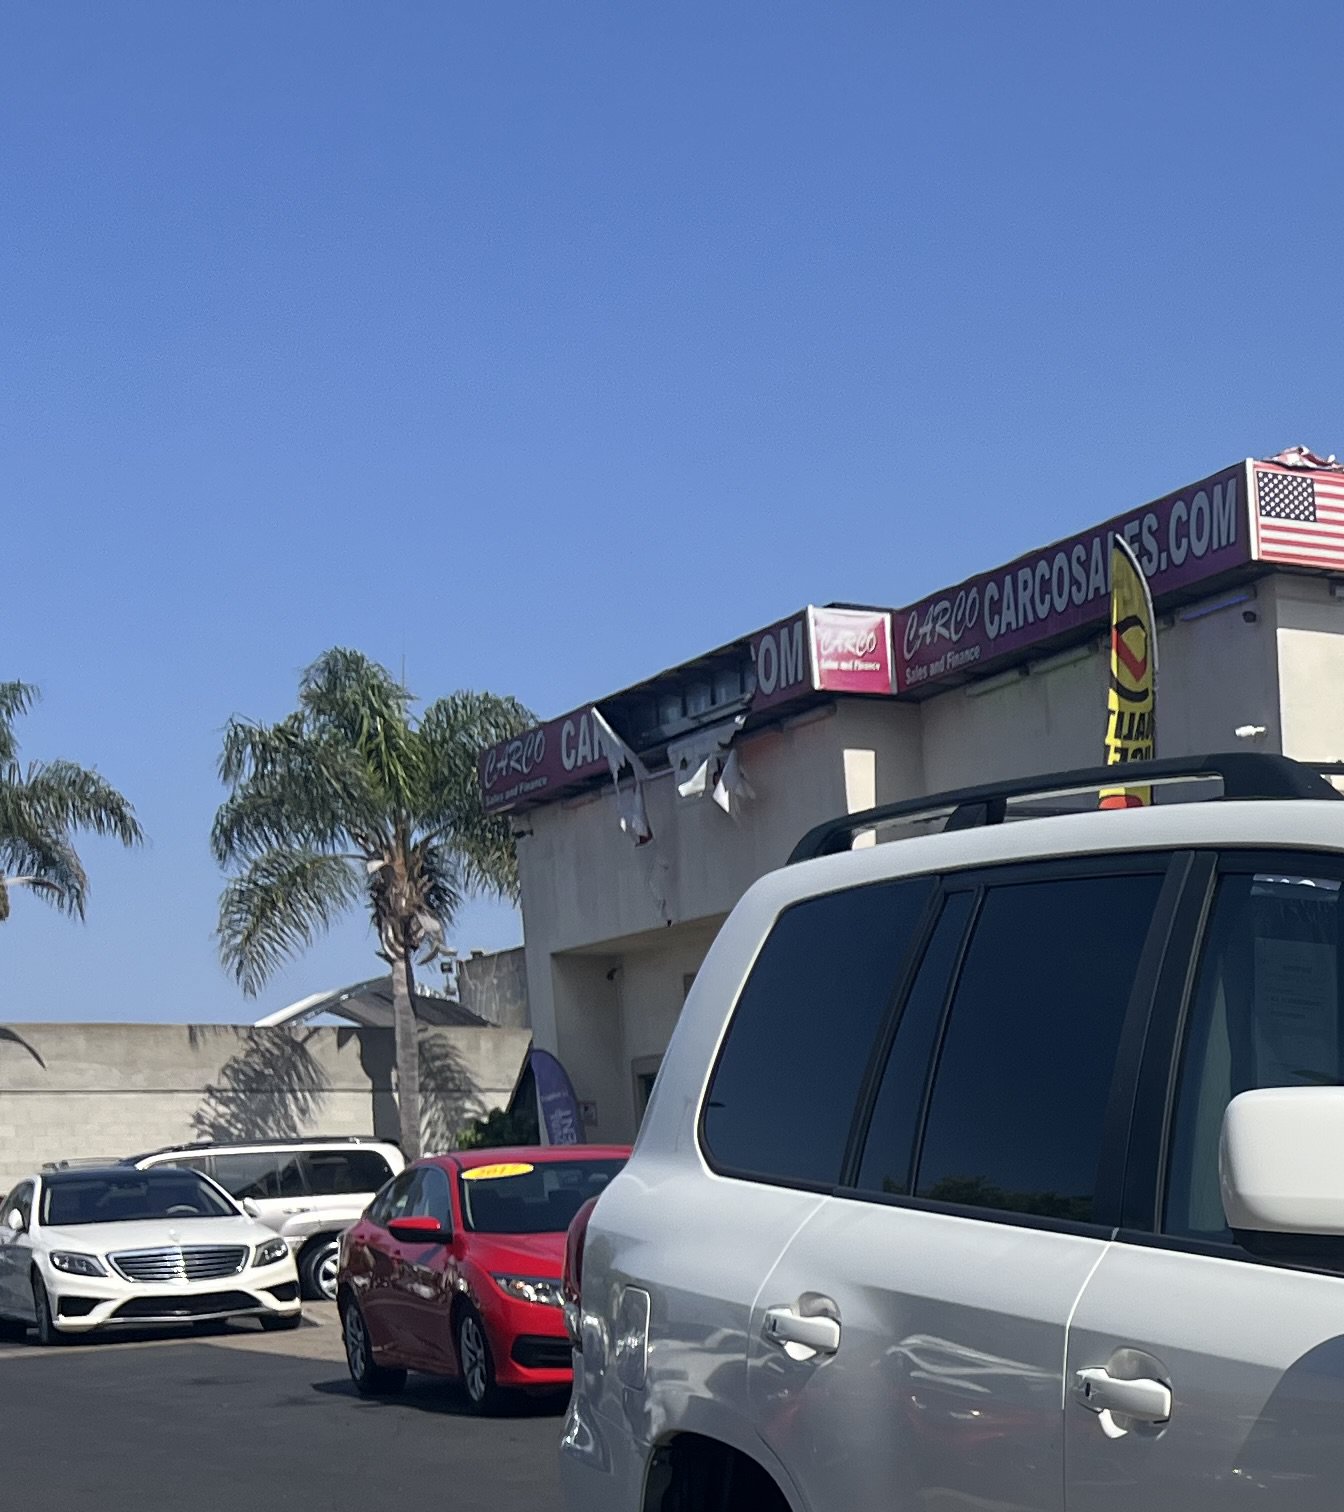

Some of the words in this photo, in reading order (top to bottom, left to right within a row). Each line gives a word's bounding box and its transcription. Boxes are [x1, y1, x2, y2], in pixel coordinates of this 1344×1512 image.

[820, 631, 878, 658] CARCO
[904, 587, 980, 661] CARCO
[905, 667, 929, 685] Sales
[929, 654, 945, 676] and
[948, 645, 981, 671] Finance
[485, 730, 546, 789] CARCO
